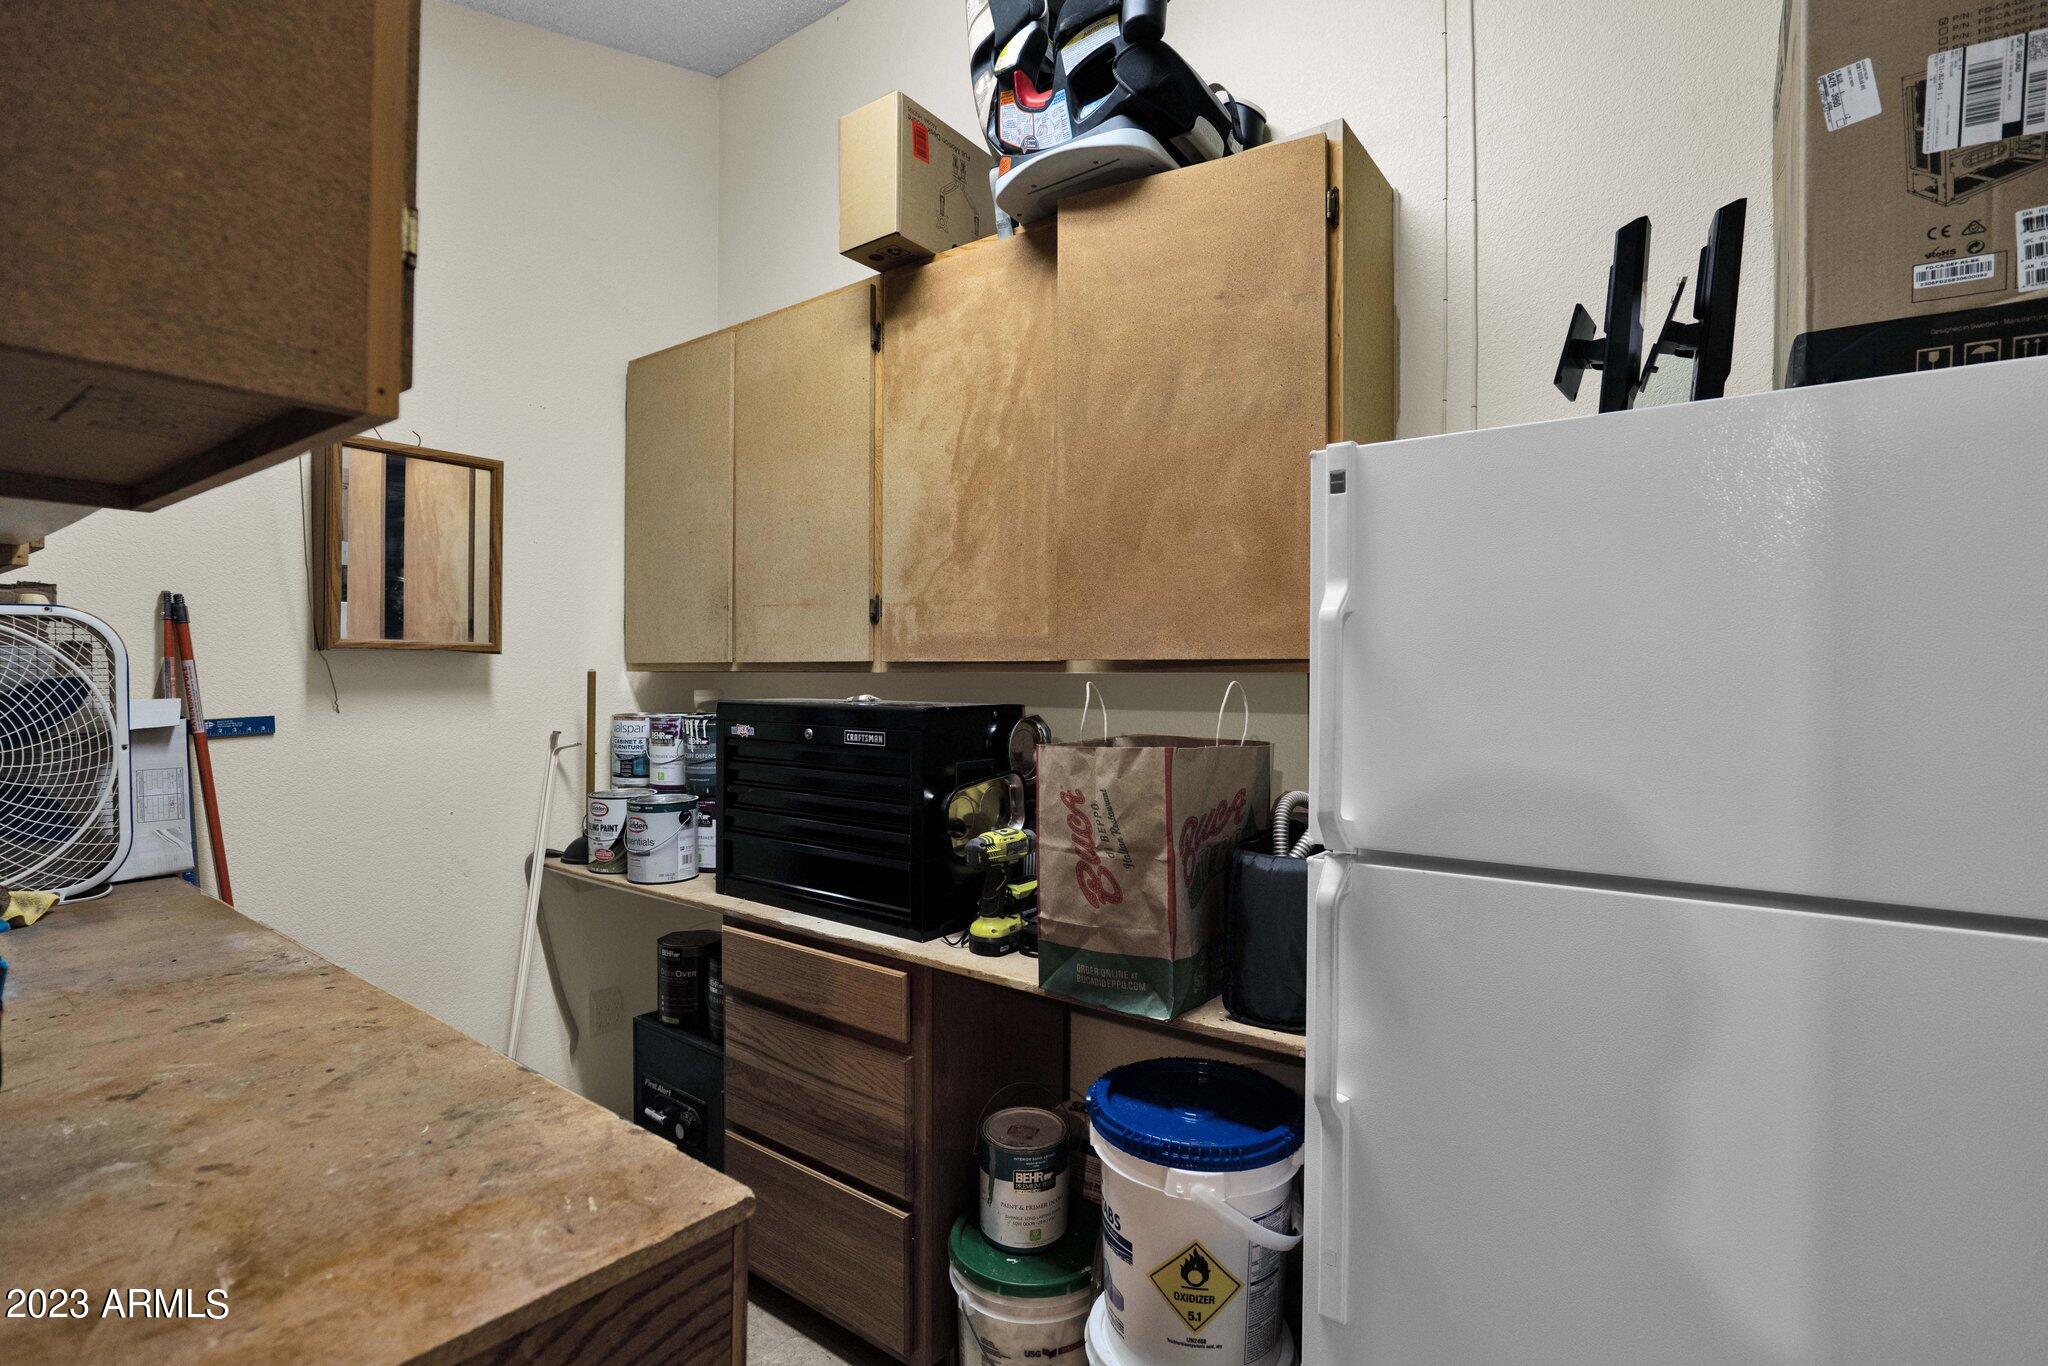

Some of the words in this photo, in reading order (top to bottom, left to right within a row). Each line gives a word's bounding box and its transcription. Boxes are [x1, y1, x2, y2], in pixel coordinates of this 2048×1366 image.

[1930, 325, 1962, 336] Designed
[1971, 320, 1999, 331] Sweden
[651, 731, 666, 740] BEHR
[846, 732, 883, 744] CRAFTSMAN
[600, 824, 619, 833] PAINT
[1091, 803, 1111, 844] BEPPO
[661, 948, 674, 957] BEHR
[1076, 963, 1099, 976] ORDER
[1100, 968, 1129, 979] ONLINE
[644, 1078, 658, 1091] First
[657, 1084, 672, 1097] Alert
[1015, 1171, 1044, 1184] BEHR
[1015, 1181, 1041, 1190] PREMIUM
[1000, 1201, 1018, 1211] PAINT
[1025, 1202, 1048, 1211] PRIMER
[1173, 1291, 1216, 1305] OXIDIZER
[1187, 1310, 1202, 1322] 5.1
[1024, 1349, 1042, 1358] USG
